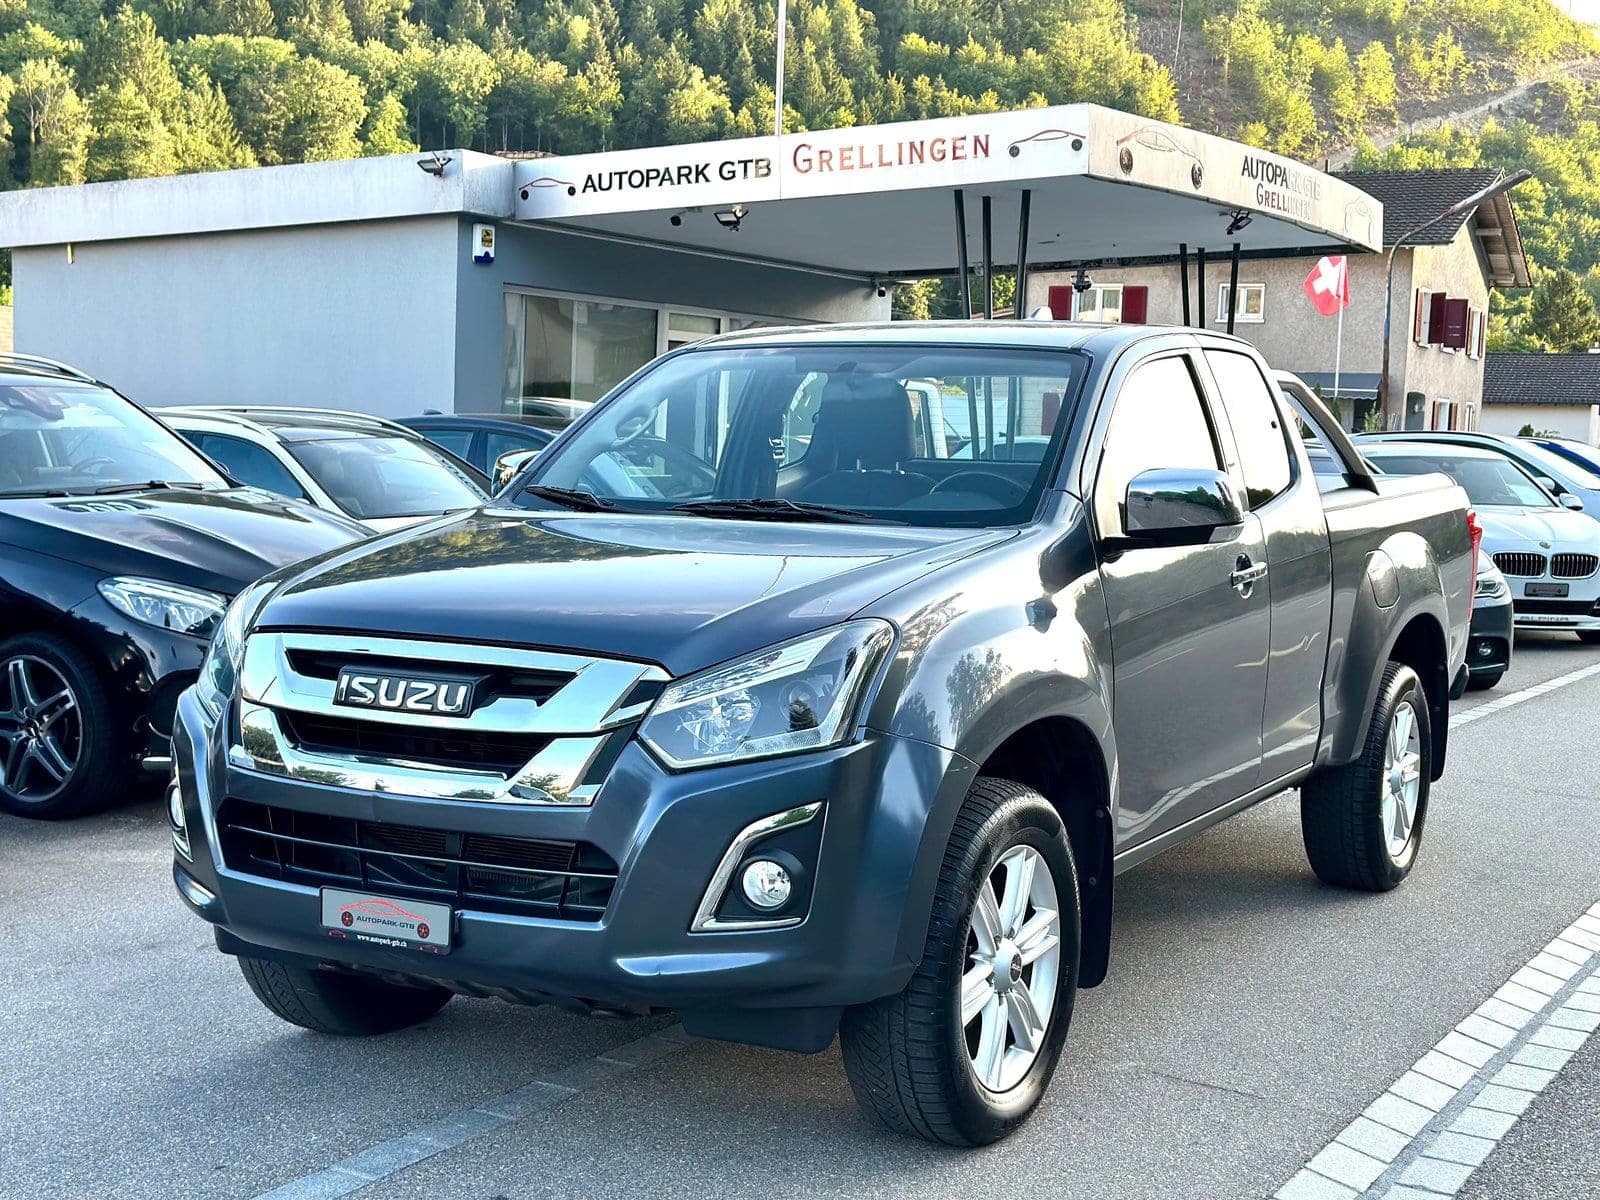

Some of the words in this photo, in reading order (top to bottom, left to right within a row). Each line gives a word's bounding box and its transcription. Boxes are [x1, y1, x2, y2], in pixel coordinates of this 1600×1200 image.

[581, 163, 711, 194] AUTOPARK
[718, 157, 772, 181] GTB
[792, 134, 990, 174] GRELLINGEN
[337, 674, 468, 713] ISUZU
